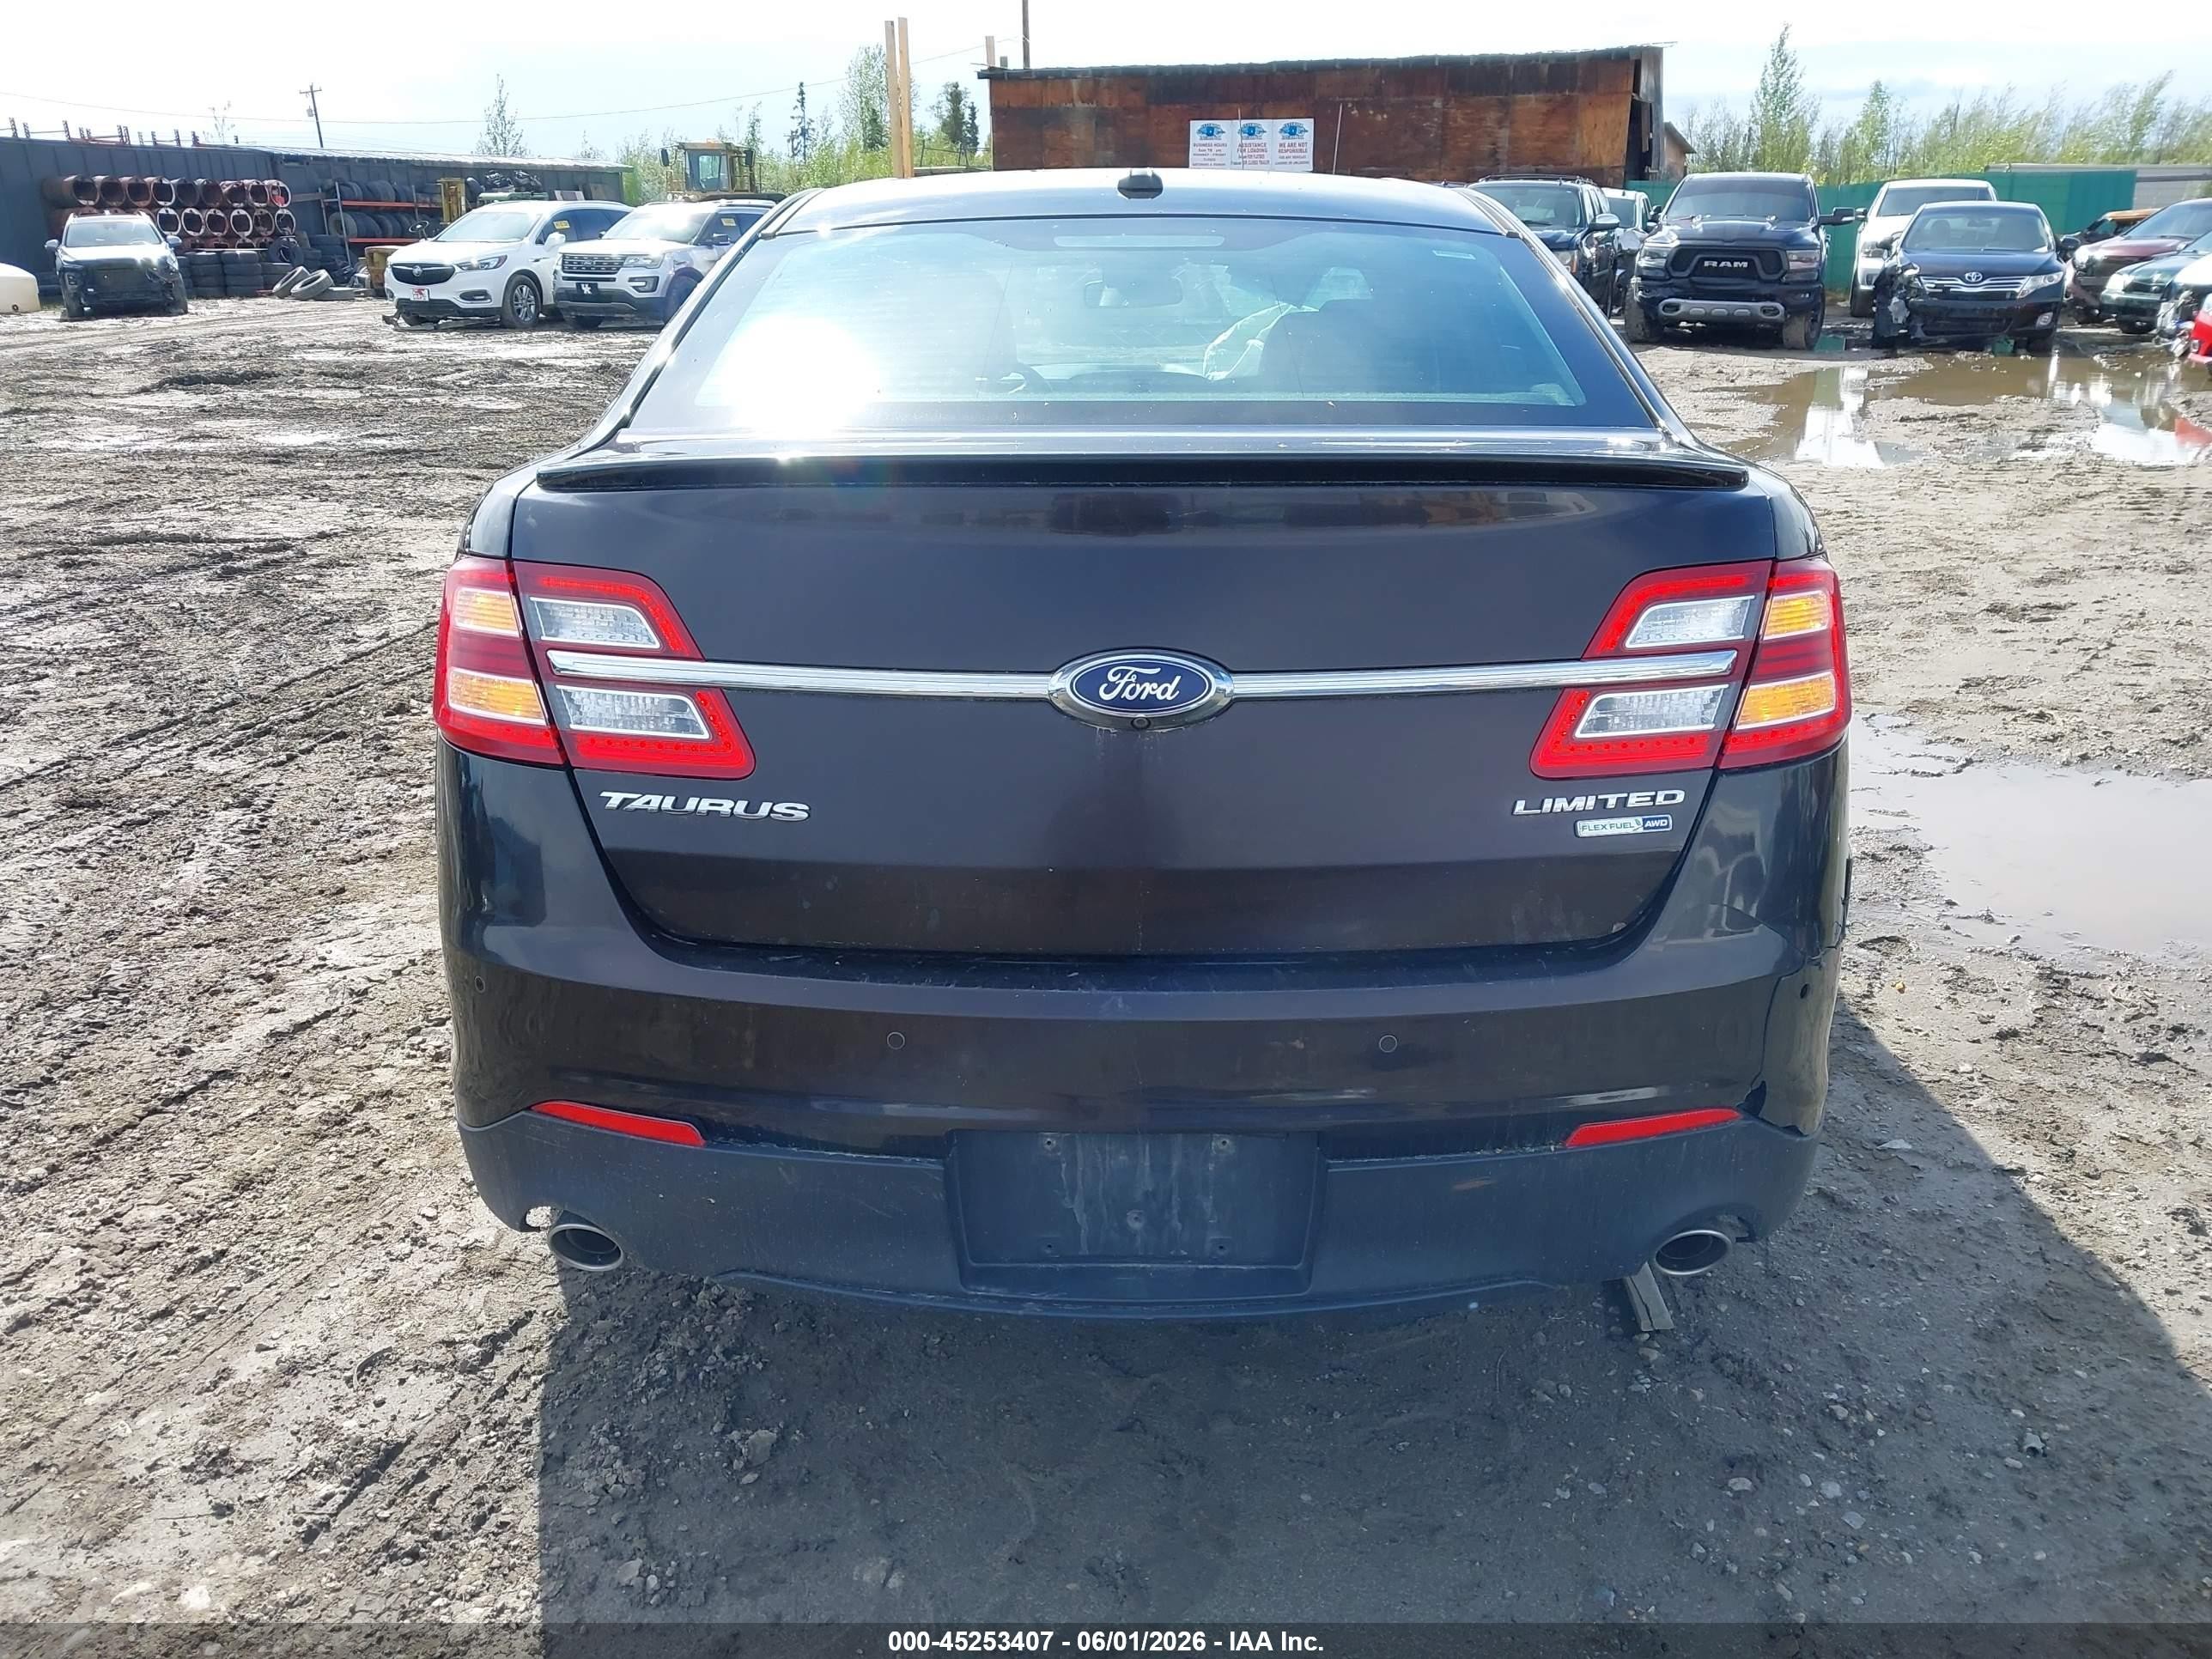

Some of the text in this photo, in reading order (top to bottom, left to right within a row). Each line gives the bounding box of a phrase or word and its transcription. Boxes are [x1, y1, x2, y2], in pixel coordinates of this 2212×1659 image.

[1098, 665, 1182, 701] Ford
[599, 791, 811, 821] TAURUS
[1512, 789, 1686, 815] LIMITED
[1581, 818, 1668, 832] FLEX FUEL AWD
